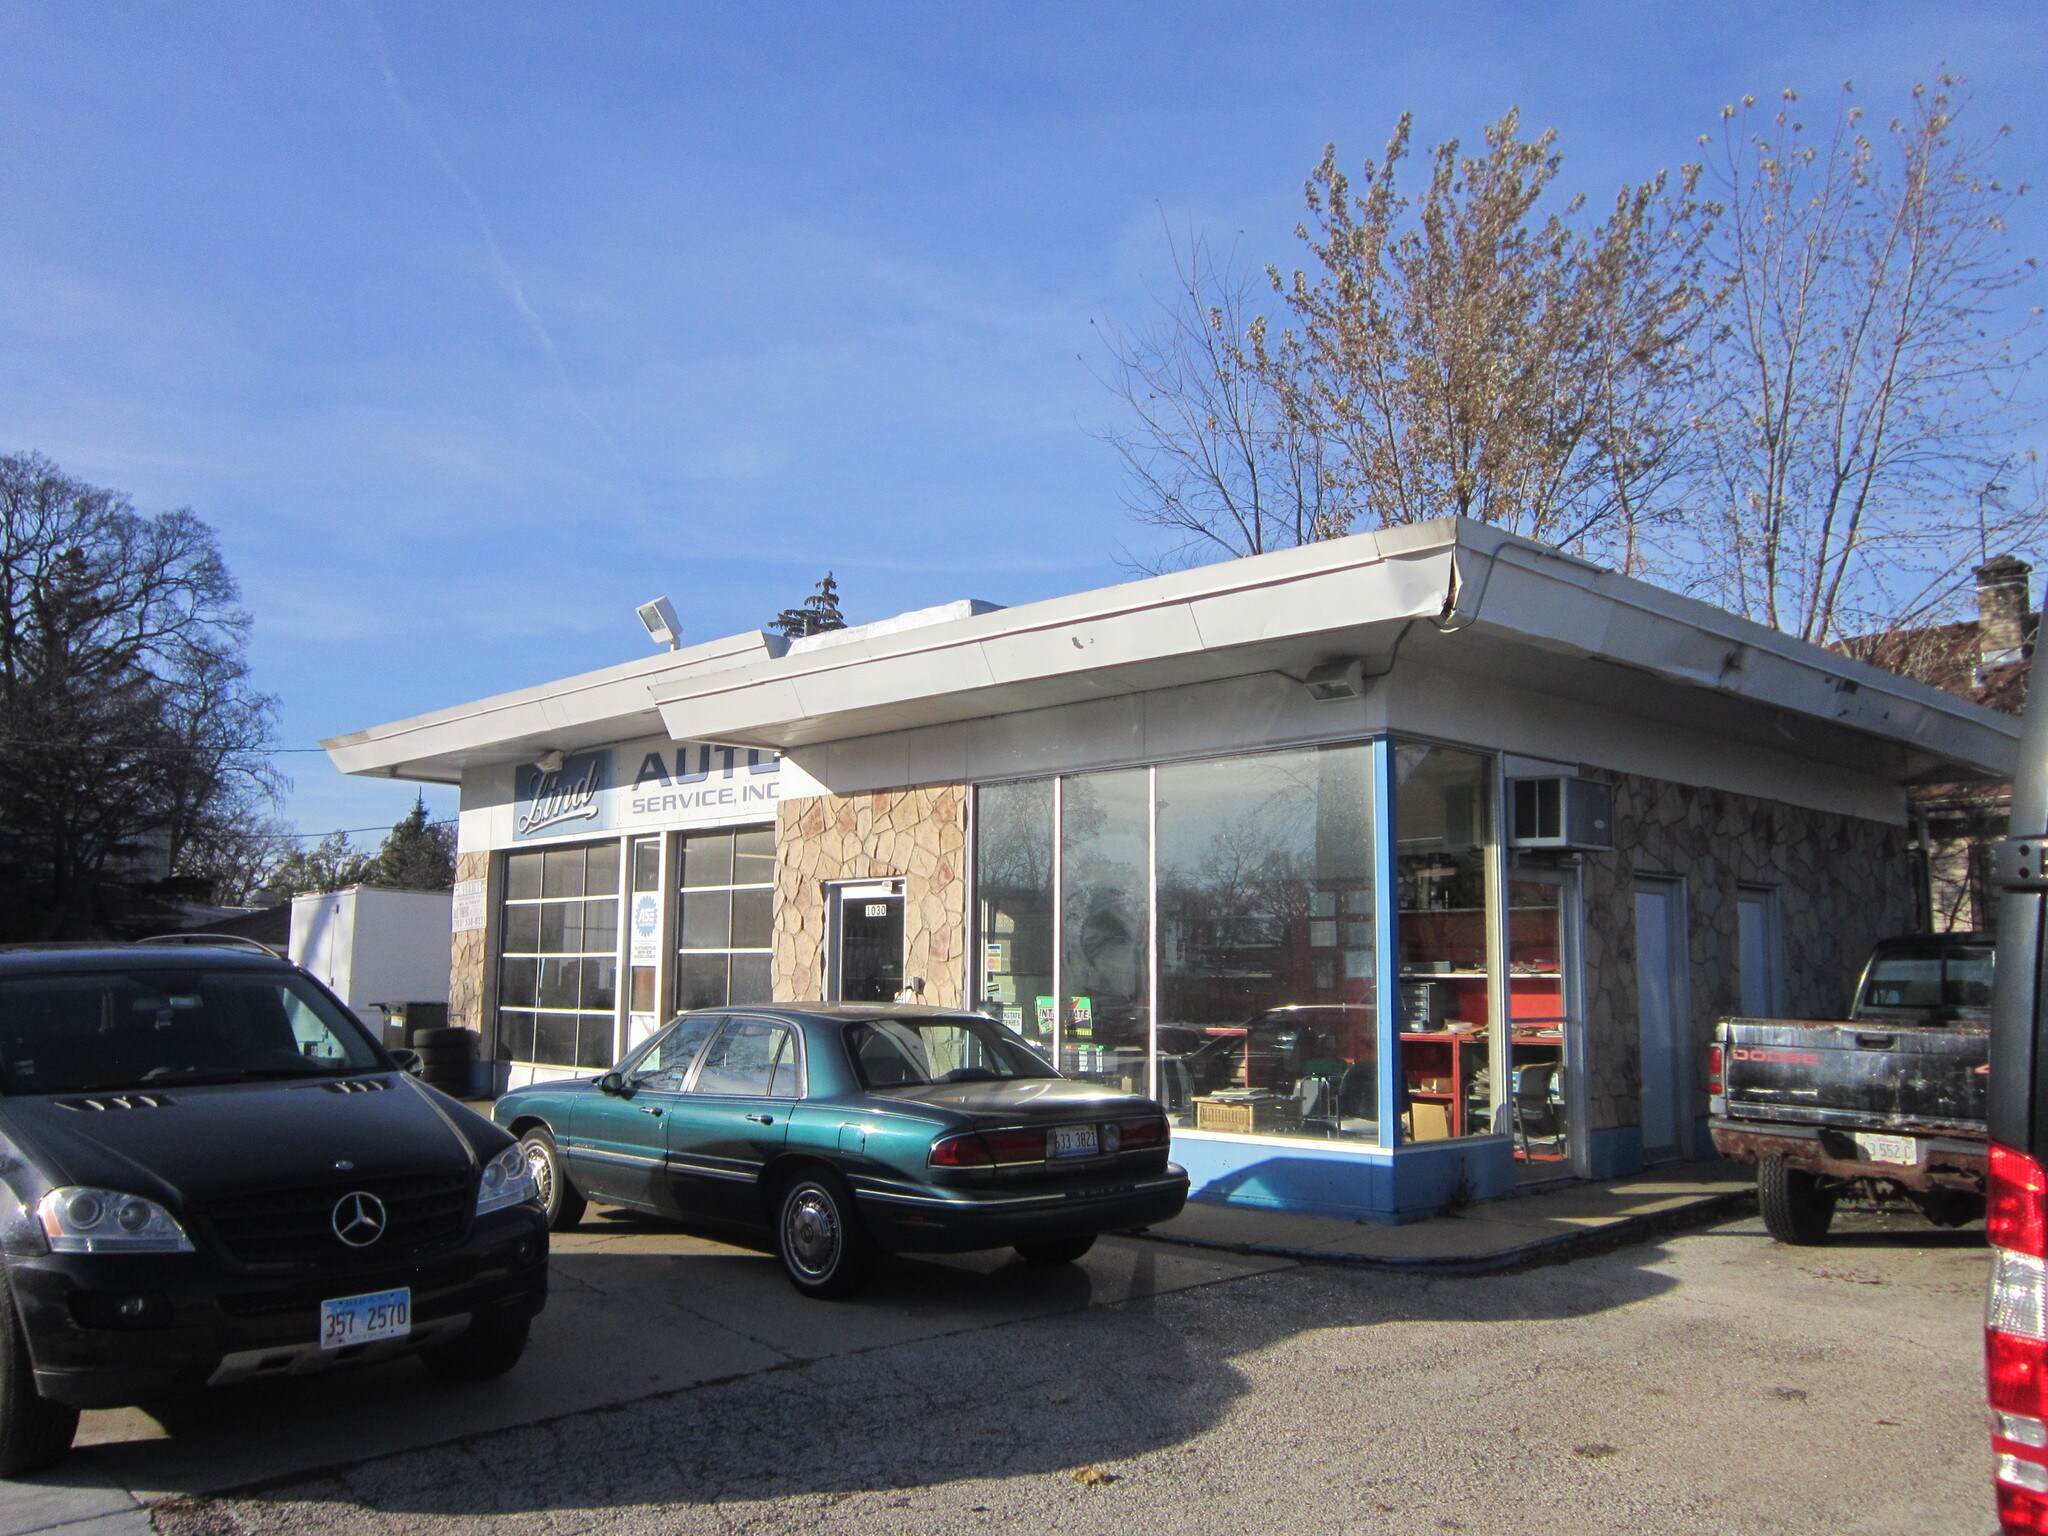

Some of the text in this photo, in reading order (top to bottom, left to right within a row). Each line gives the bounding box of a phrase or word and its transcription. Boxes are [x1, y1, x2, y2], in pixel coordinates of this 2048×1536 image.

[631, 744, 780, 791] AUTO
[518, 760, 600, 834] Lind
[638, 908, 655, 923] ASE
[866, 905, 886, 916] 1030
[1732, 1049, 1818, 1064] DODGE
[1076, 1131, 1097, 1147] 3821
[1879, 1143, 1901, 1158] 552
[326, 1303, 406, 1338] 357 2570
